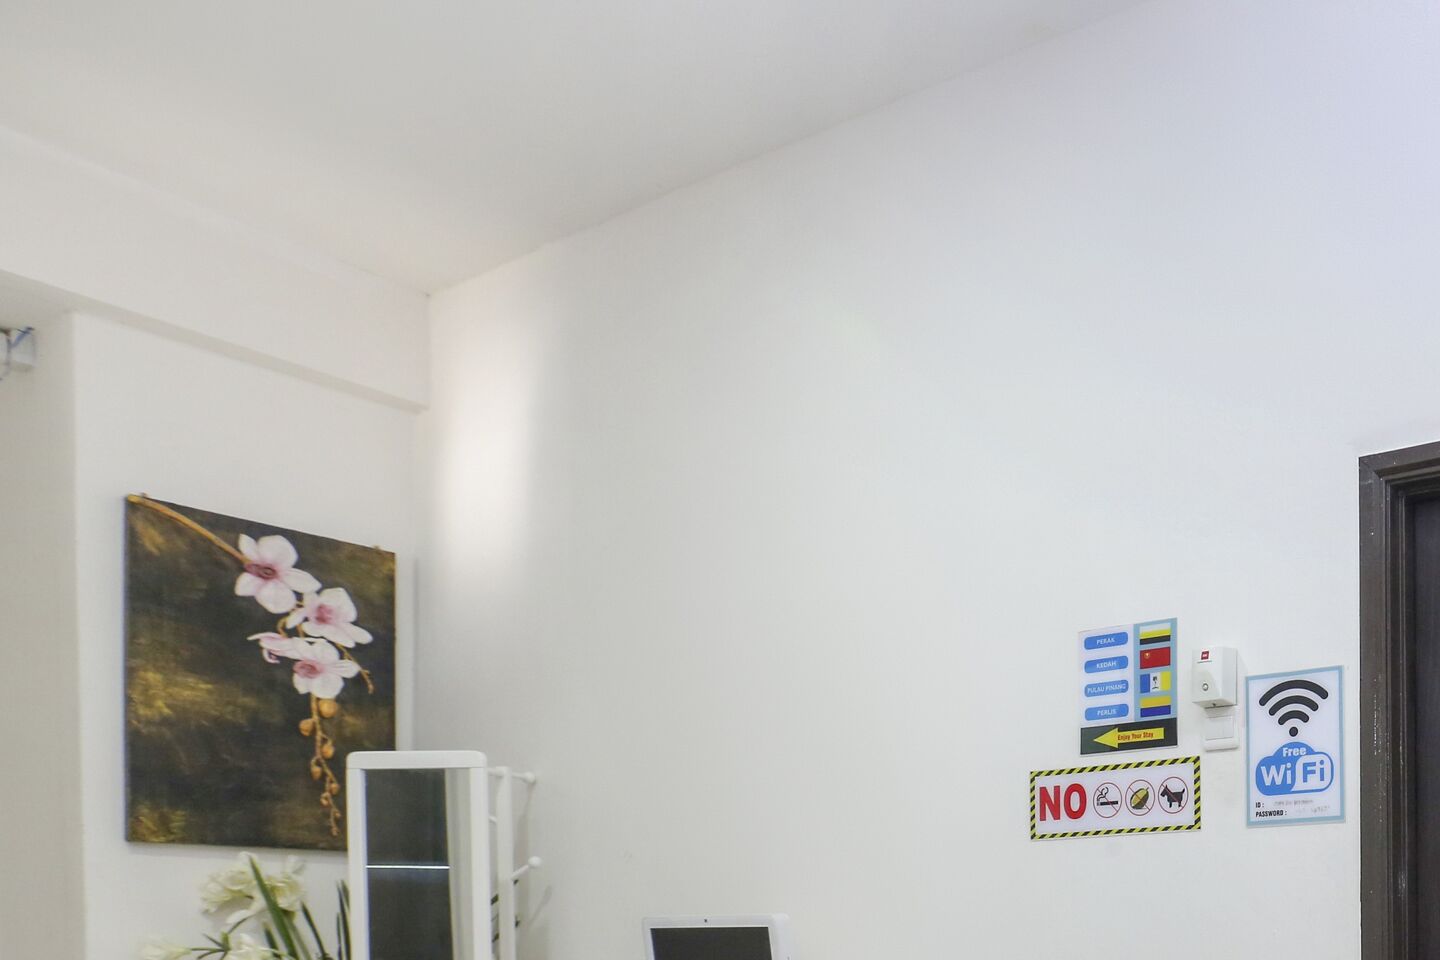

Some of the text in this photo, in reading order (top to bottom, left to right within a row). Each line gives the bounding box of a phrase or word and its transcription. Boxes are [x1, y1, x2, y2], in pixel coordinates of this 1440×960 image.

[1087, 683, 1126, 694] PULAU PINANG
[1118, 730, 1154, 742] Enjoy Your Stay
[1283, 747, 1307, 757] Free
[1039, 783, 1087, 822] NO
